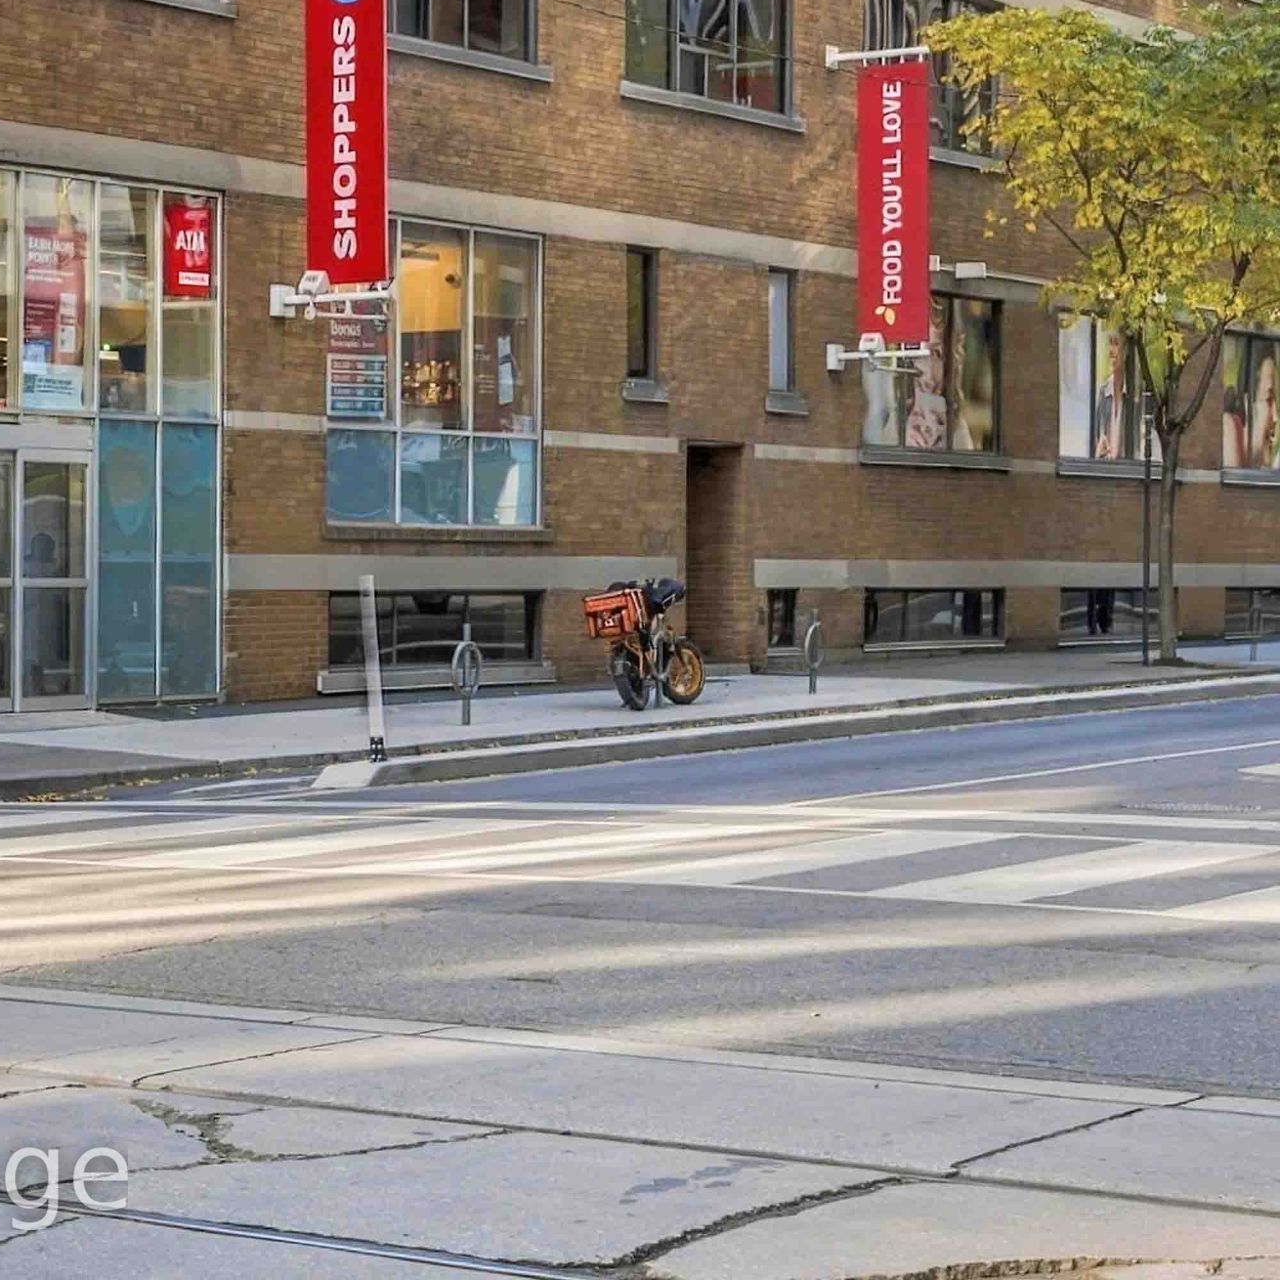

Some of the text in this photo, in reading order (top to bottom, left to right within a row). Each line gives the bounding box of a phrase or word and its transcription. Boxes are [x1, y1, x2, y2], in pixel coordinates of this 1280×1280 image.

[175, 230, 206, 252] ATM
[332, 14, 358, 260] SHOPPERS
[881, 80, 903, 305] FOOD YOU'LL LOVE
